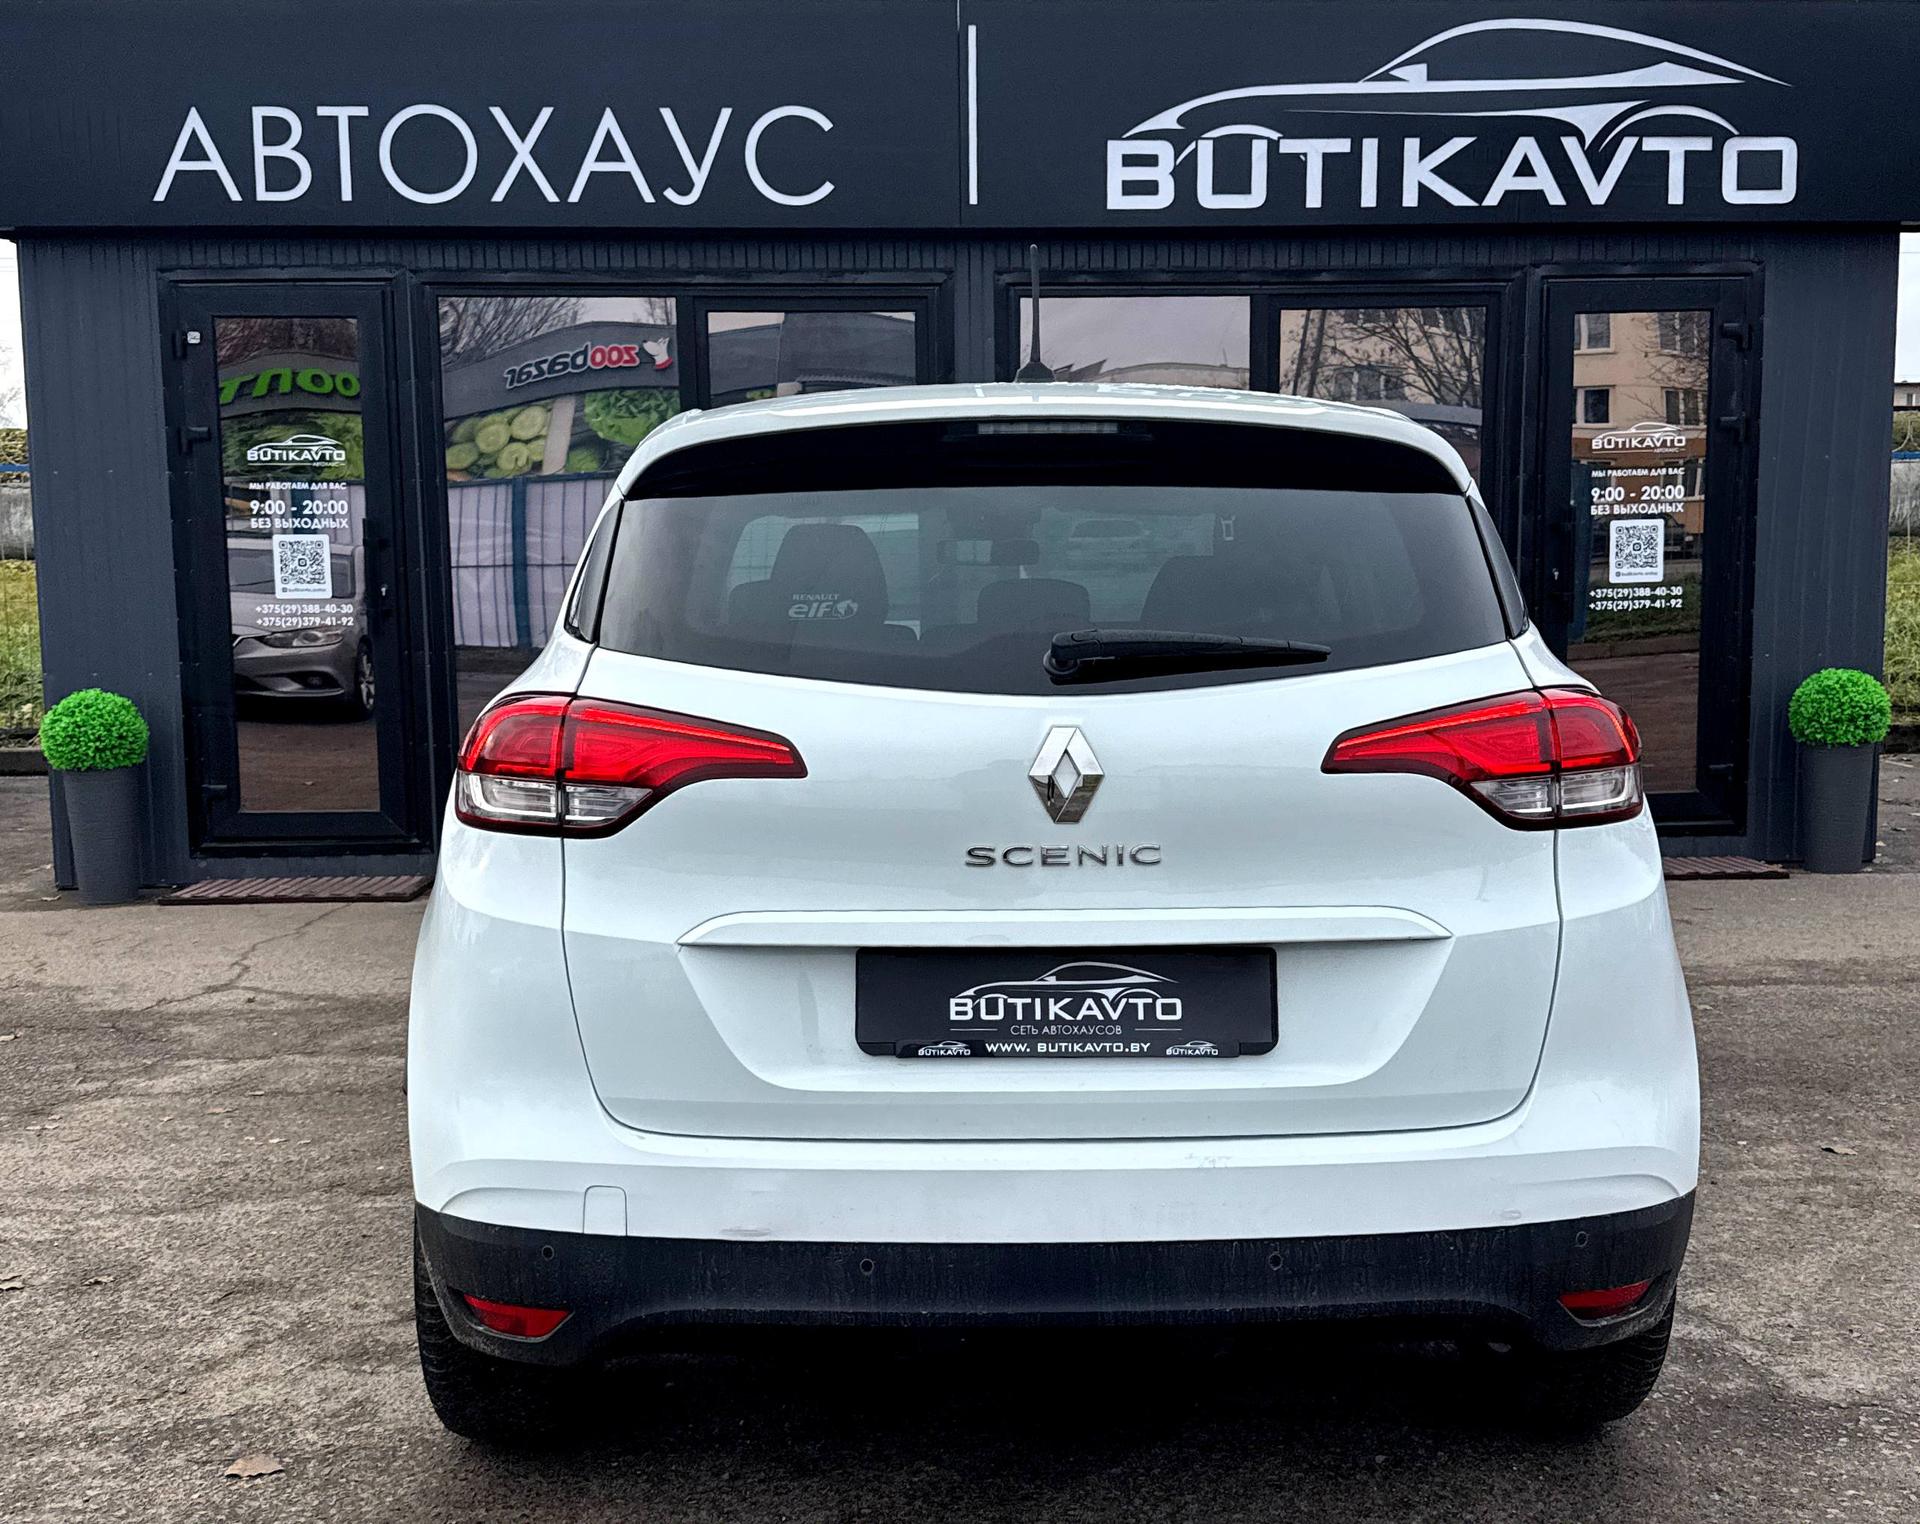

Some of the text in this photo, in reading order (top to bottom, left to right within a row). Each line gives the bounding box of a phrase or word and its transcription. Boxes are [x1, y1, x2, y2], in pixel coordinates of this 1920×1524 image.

[153, 104, 836, 206] АВТОХАУС
[1106, 136, 1798, 210] BUTIKAVTO
[1591, 436, 1686, 449] BUTIKAVTO
[247, 449, 346, 461] BUTIKAVTO
[1591, 467, 1685, 478] МЫ РАБОТАЕМ ДЛЯ ВАС
[249, 482, 347, 490] МЫ РАБОТАЕМ ДЛЯ ВАС
[1591, 487, 1625, 502] 9:00
[1640, 485, 1685, 500] 20:00
[250, 500, 286, 515] 9:00
[302, 500, 349, 515] 20:00
[1590, 502, 1685, 515] БЕЗ ВЫХОДНЫХ
[250, 518, 349, 530] БЕЗ ВЫХОДНЫХ
[792, 593, 840, 601] RENAULT
[1589, 586, 1683, 599] +375(29)388-40-30
[255, 603, 354, 615] +375(29)388-40-30
[788, 601, 834, 618] elf
[1589, 599, 1683, 611] +375(29)379-41-92
[256, 616, 354, 628] +375(29)379-41-92
[965, 843, 1162, 867] SCENIC
[949, 998, 1183, 1021] BUTIKAVTO
[1010, 1024, 1122, 1036] СЕТЬ АВТОХАУСОВ
[918, 1048, 971, 1056] BUTIKAVTO
[985, 1043, 1151, 1053] WWW. BUTIKAVTO.BY
[1166, 1048, 1219, 1056] BUTIKAVTO
